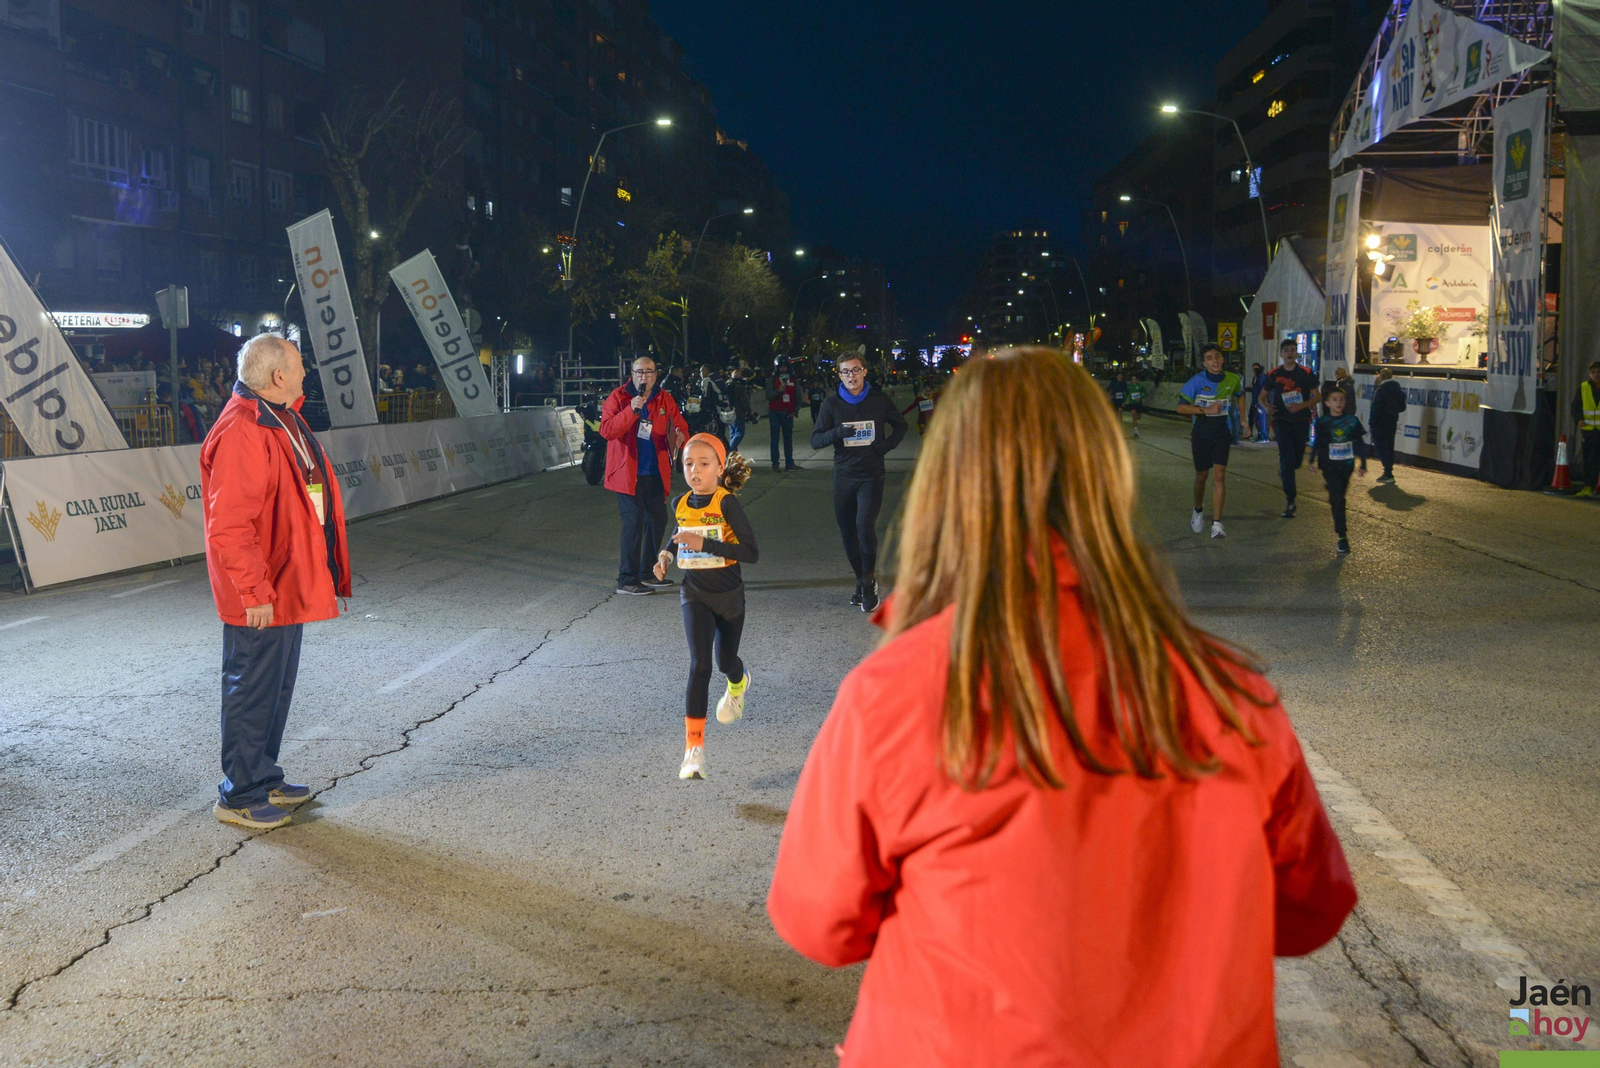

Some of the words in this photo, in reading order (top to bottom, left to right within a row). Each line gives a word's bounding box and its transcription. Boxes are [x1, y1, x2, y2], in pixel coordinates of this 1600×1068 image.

[1427, 243, 1472, 256] calderón
[1508, 278, 1536, 326] SAN
[56, 315, 102, 326] AFETERIA
[66, 499, 99, 517] CAJA
[99, 492, 146, 513] RURAL
[94, 511, 128, 534] JAÉN
